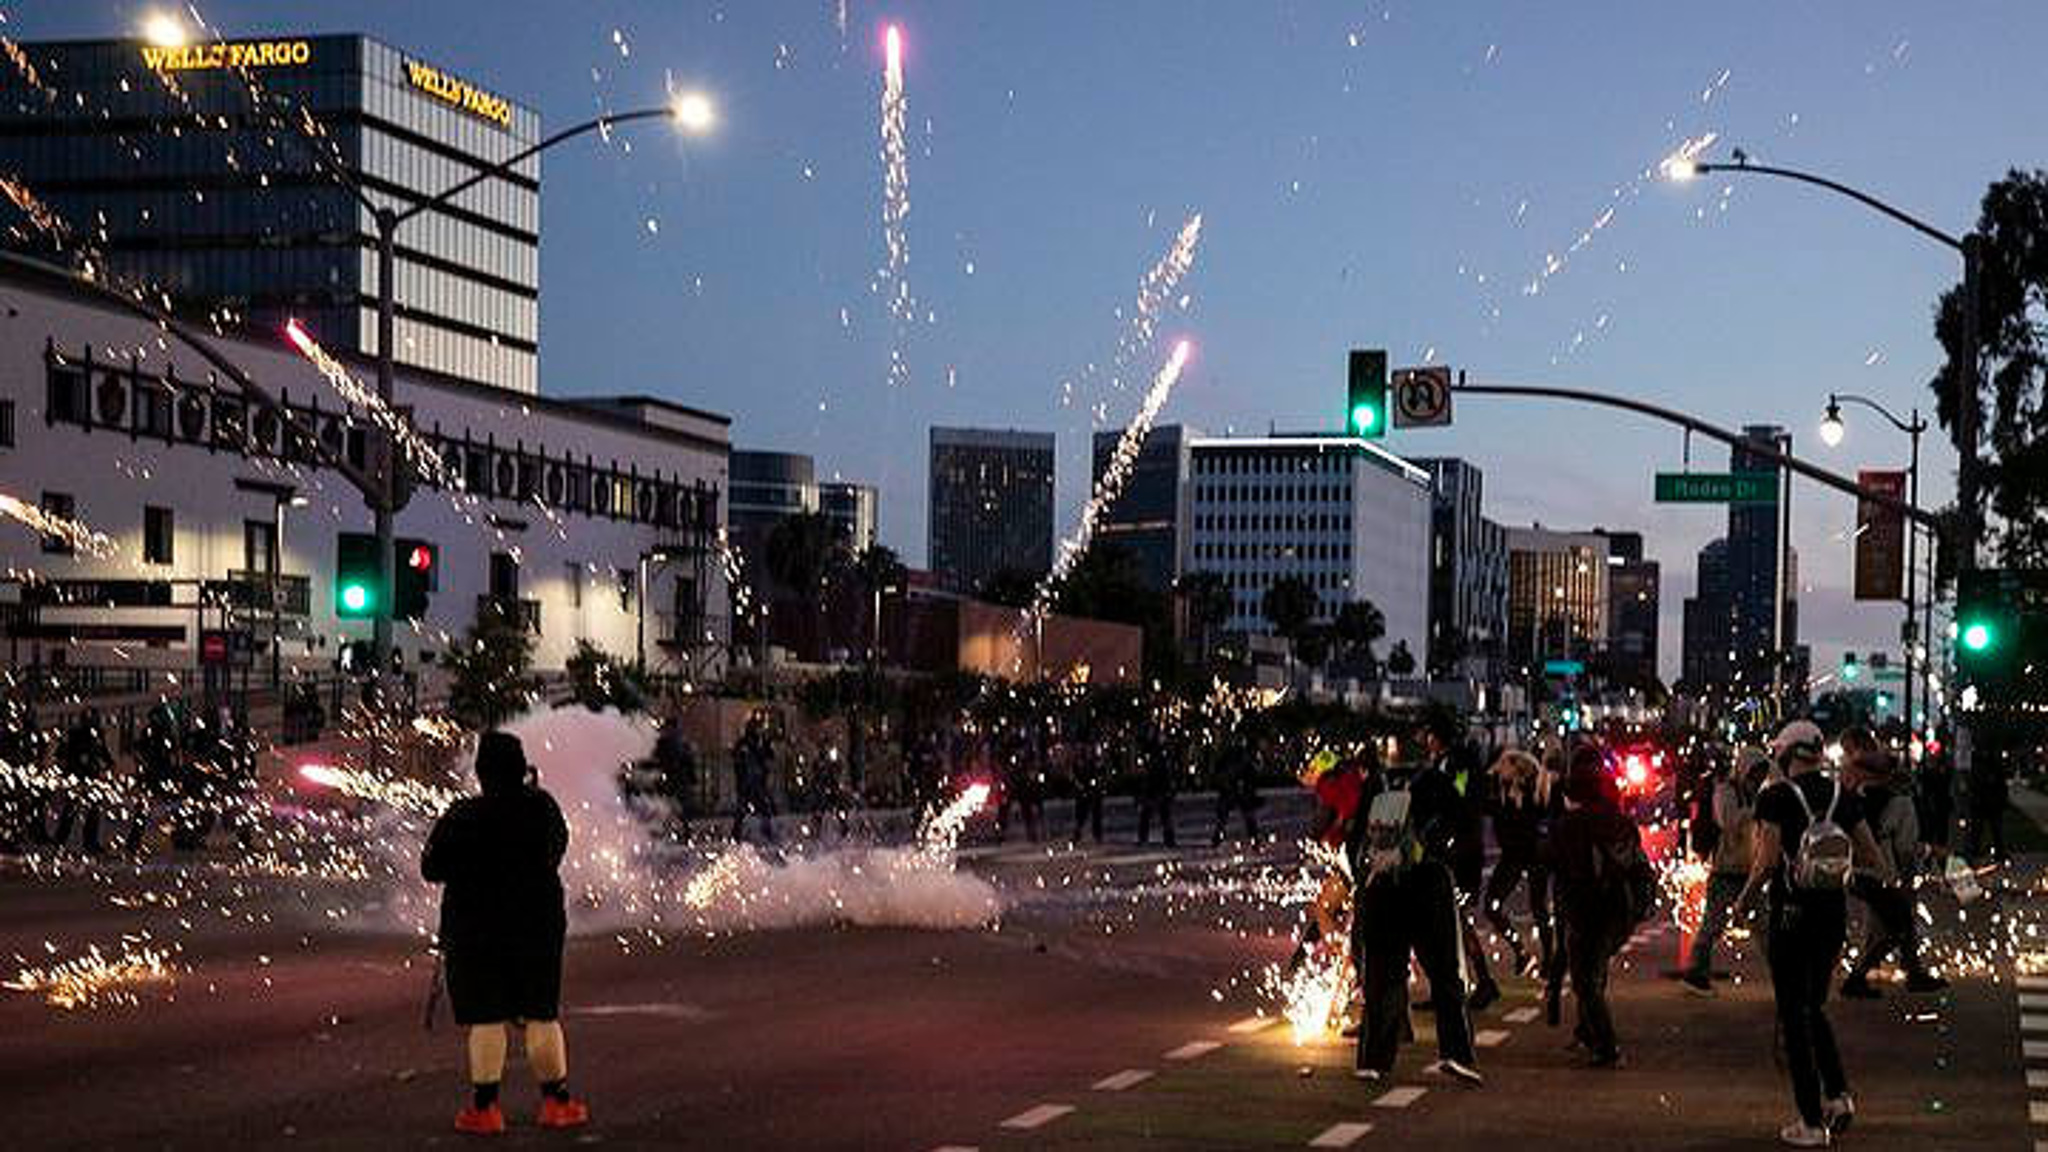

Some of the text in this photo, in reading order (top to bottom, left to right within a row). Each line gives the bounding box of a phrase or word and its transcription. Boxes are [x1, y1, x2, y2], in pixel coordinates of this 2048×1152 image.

[141, 42, 310, 68] WELLS FARGO
[408, 61, 510, 126] WELLS FARGO
[1674, 480, 1757, 498] Rodeo Dr
